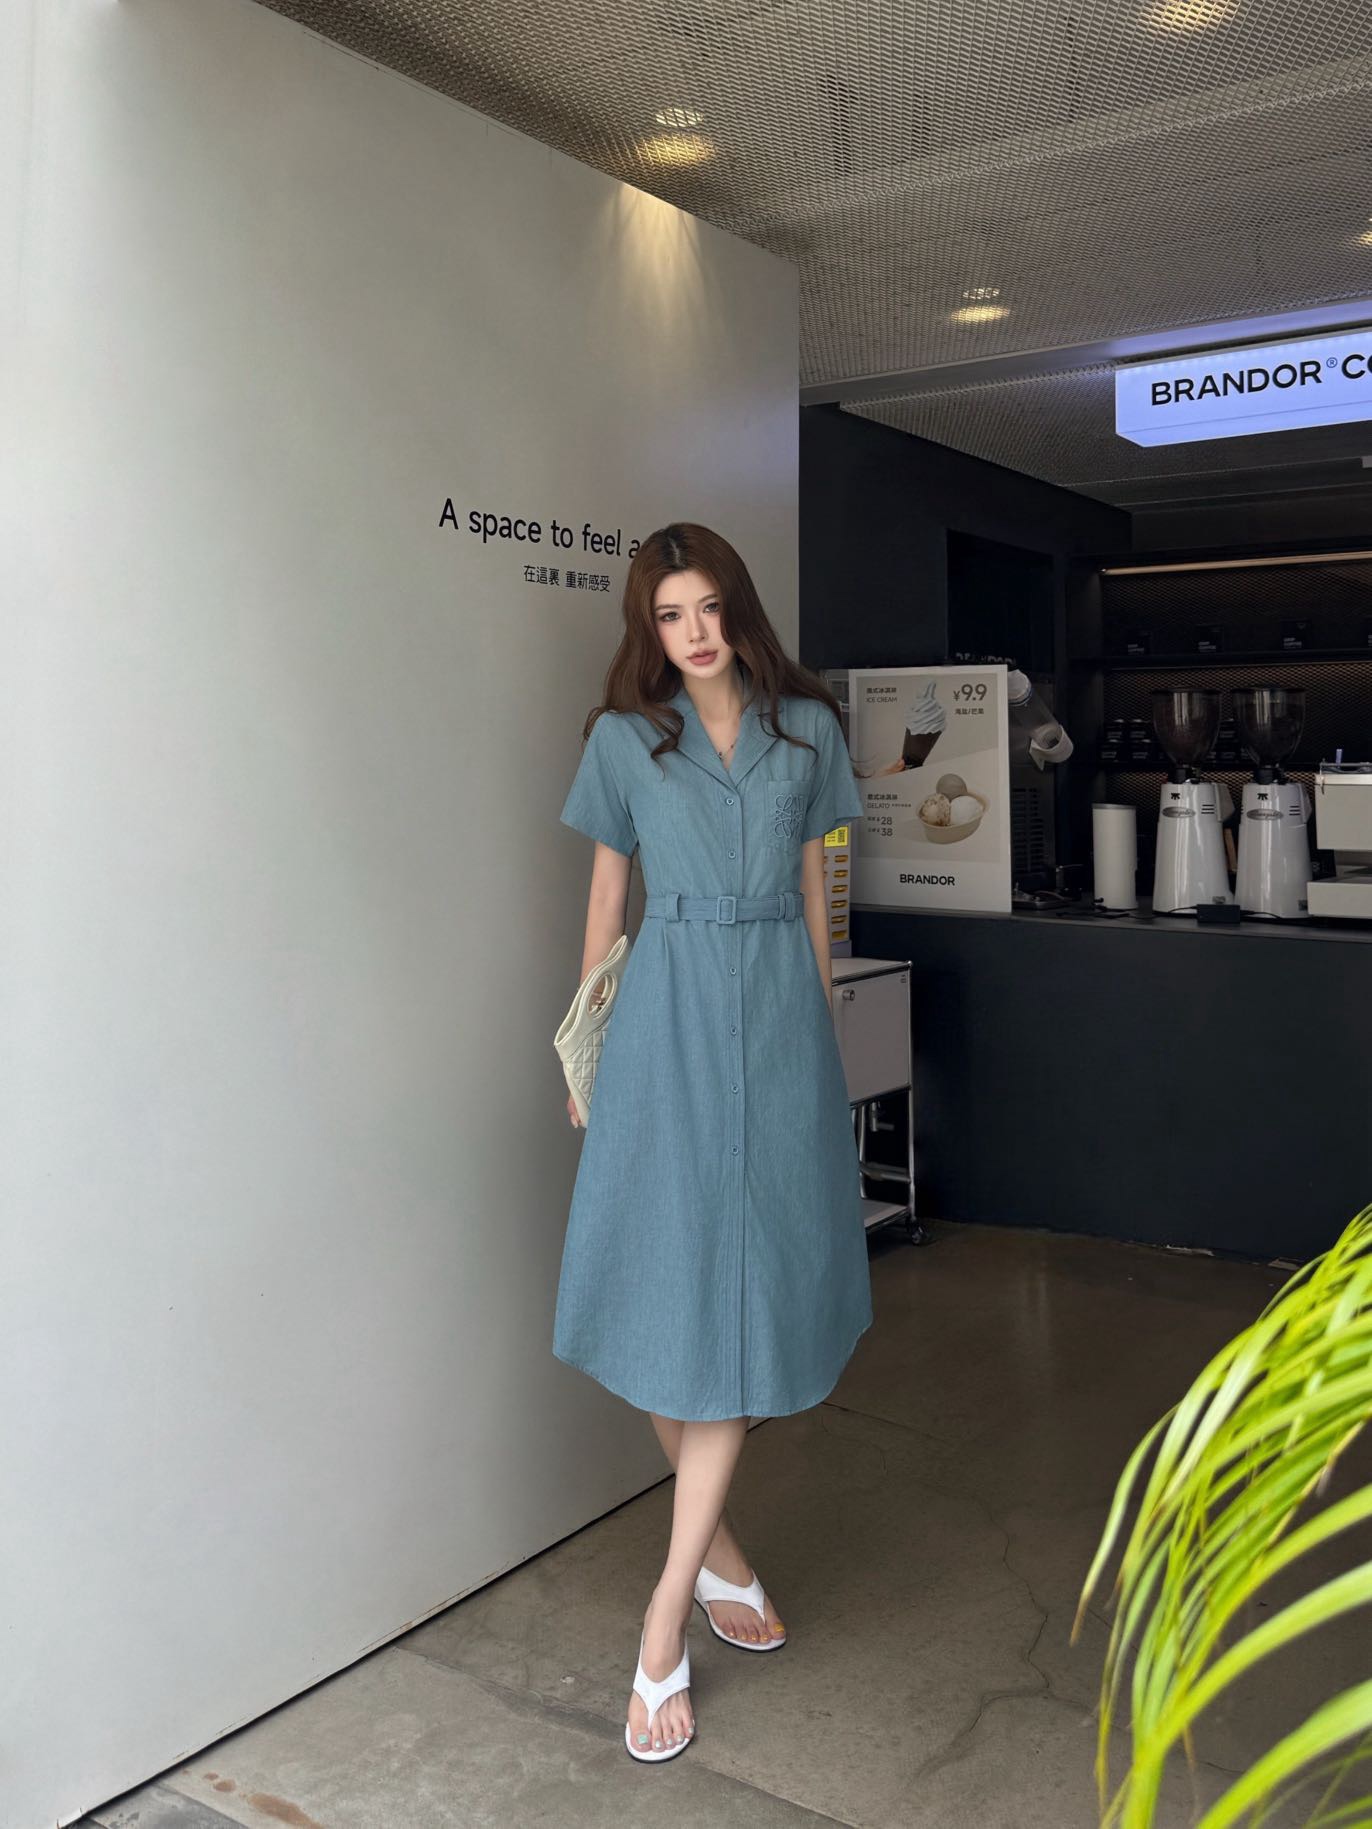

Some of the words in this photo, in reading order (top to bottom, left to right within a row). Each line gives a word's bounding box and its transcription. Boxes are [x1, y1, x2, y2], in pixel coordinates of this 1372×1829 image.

[1341, 354, 1372, 380] C
[439, 498, 459, 530] A
[469, 510, 542, 543] space
[551, 519, 574, 549] to
[582, 523, 621, 556] feel
[524, 565, 560, 587] 在這裏
[566, 571, 611, 593] 重新感受
[900, 873, 956, 887] BRANDOR
